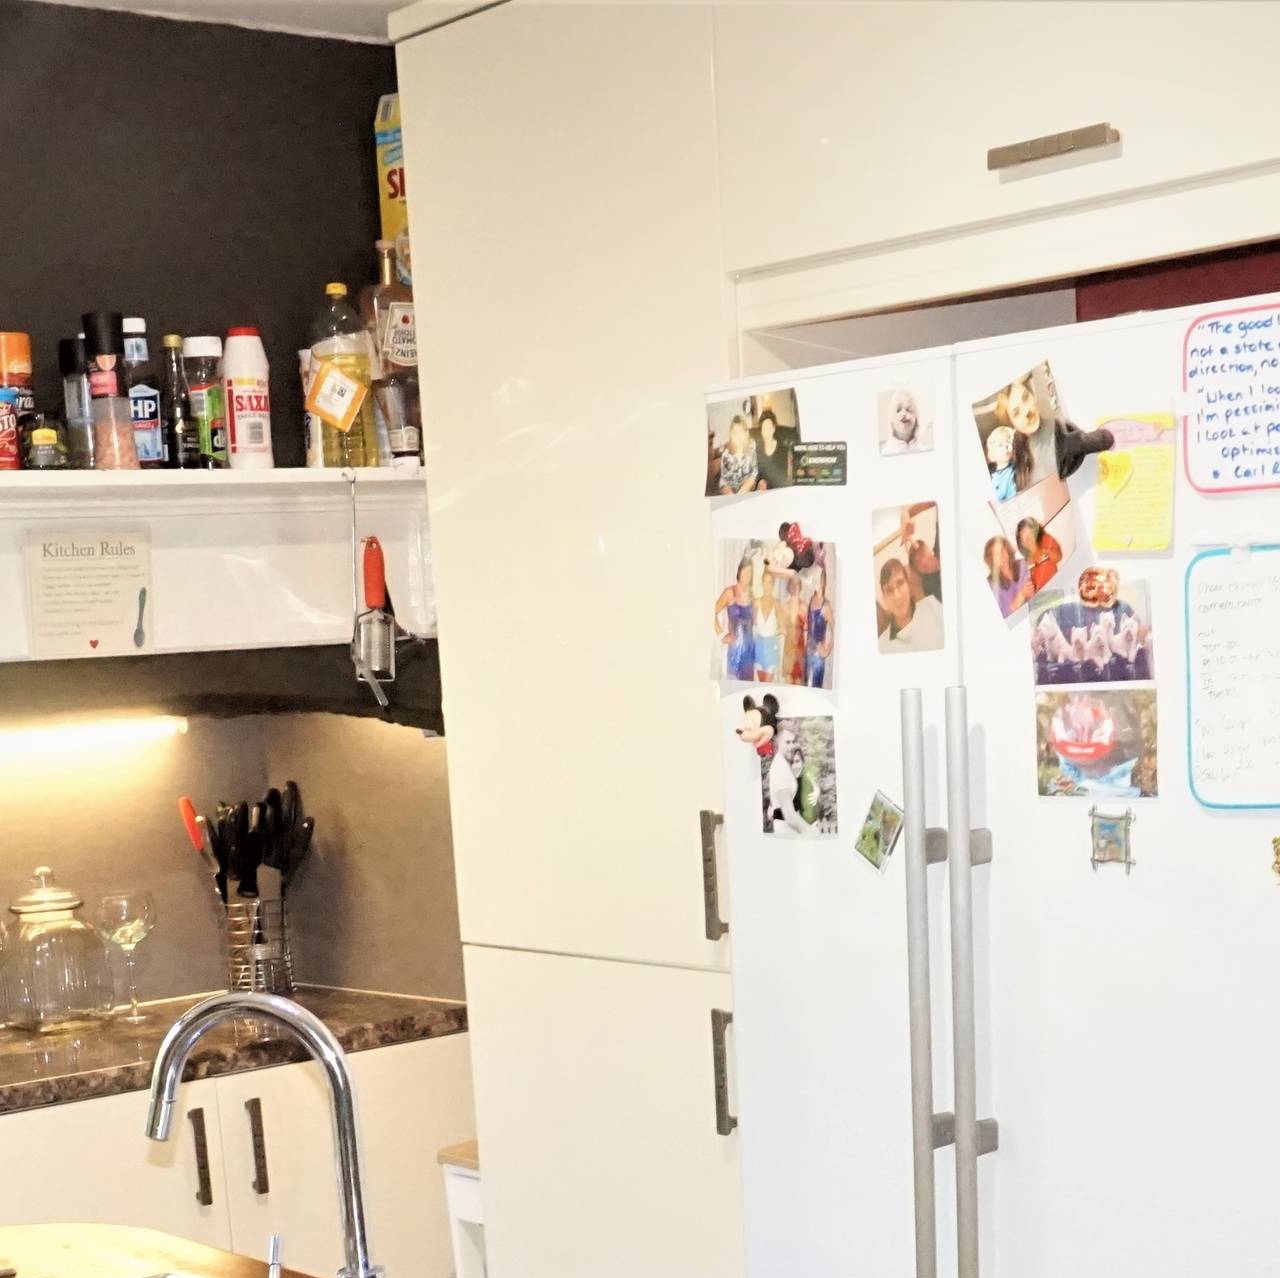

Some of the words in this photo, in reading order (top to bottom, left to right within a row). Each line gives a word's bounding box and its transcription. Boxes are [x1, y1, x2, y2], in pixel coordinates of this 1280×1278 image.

[1238, 314, 1273, 339] good
[1190, 345, 1214, 358] not
[1234, 340, 1275, 355] state
[130, 399, 156, 419] HP
[1234, 463, 1265, 478] Carl
[41, 541, 95, 558] Kitchen
[100, 540, 136, 557] Rules
